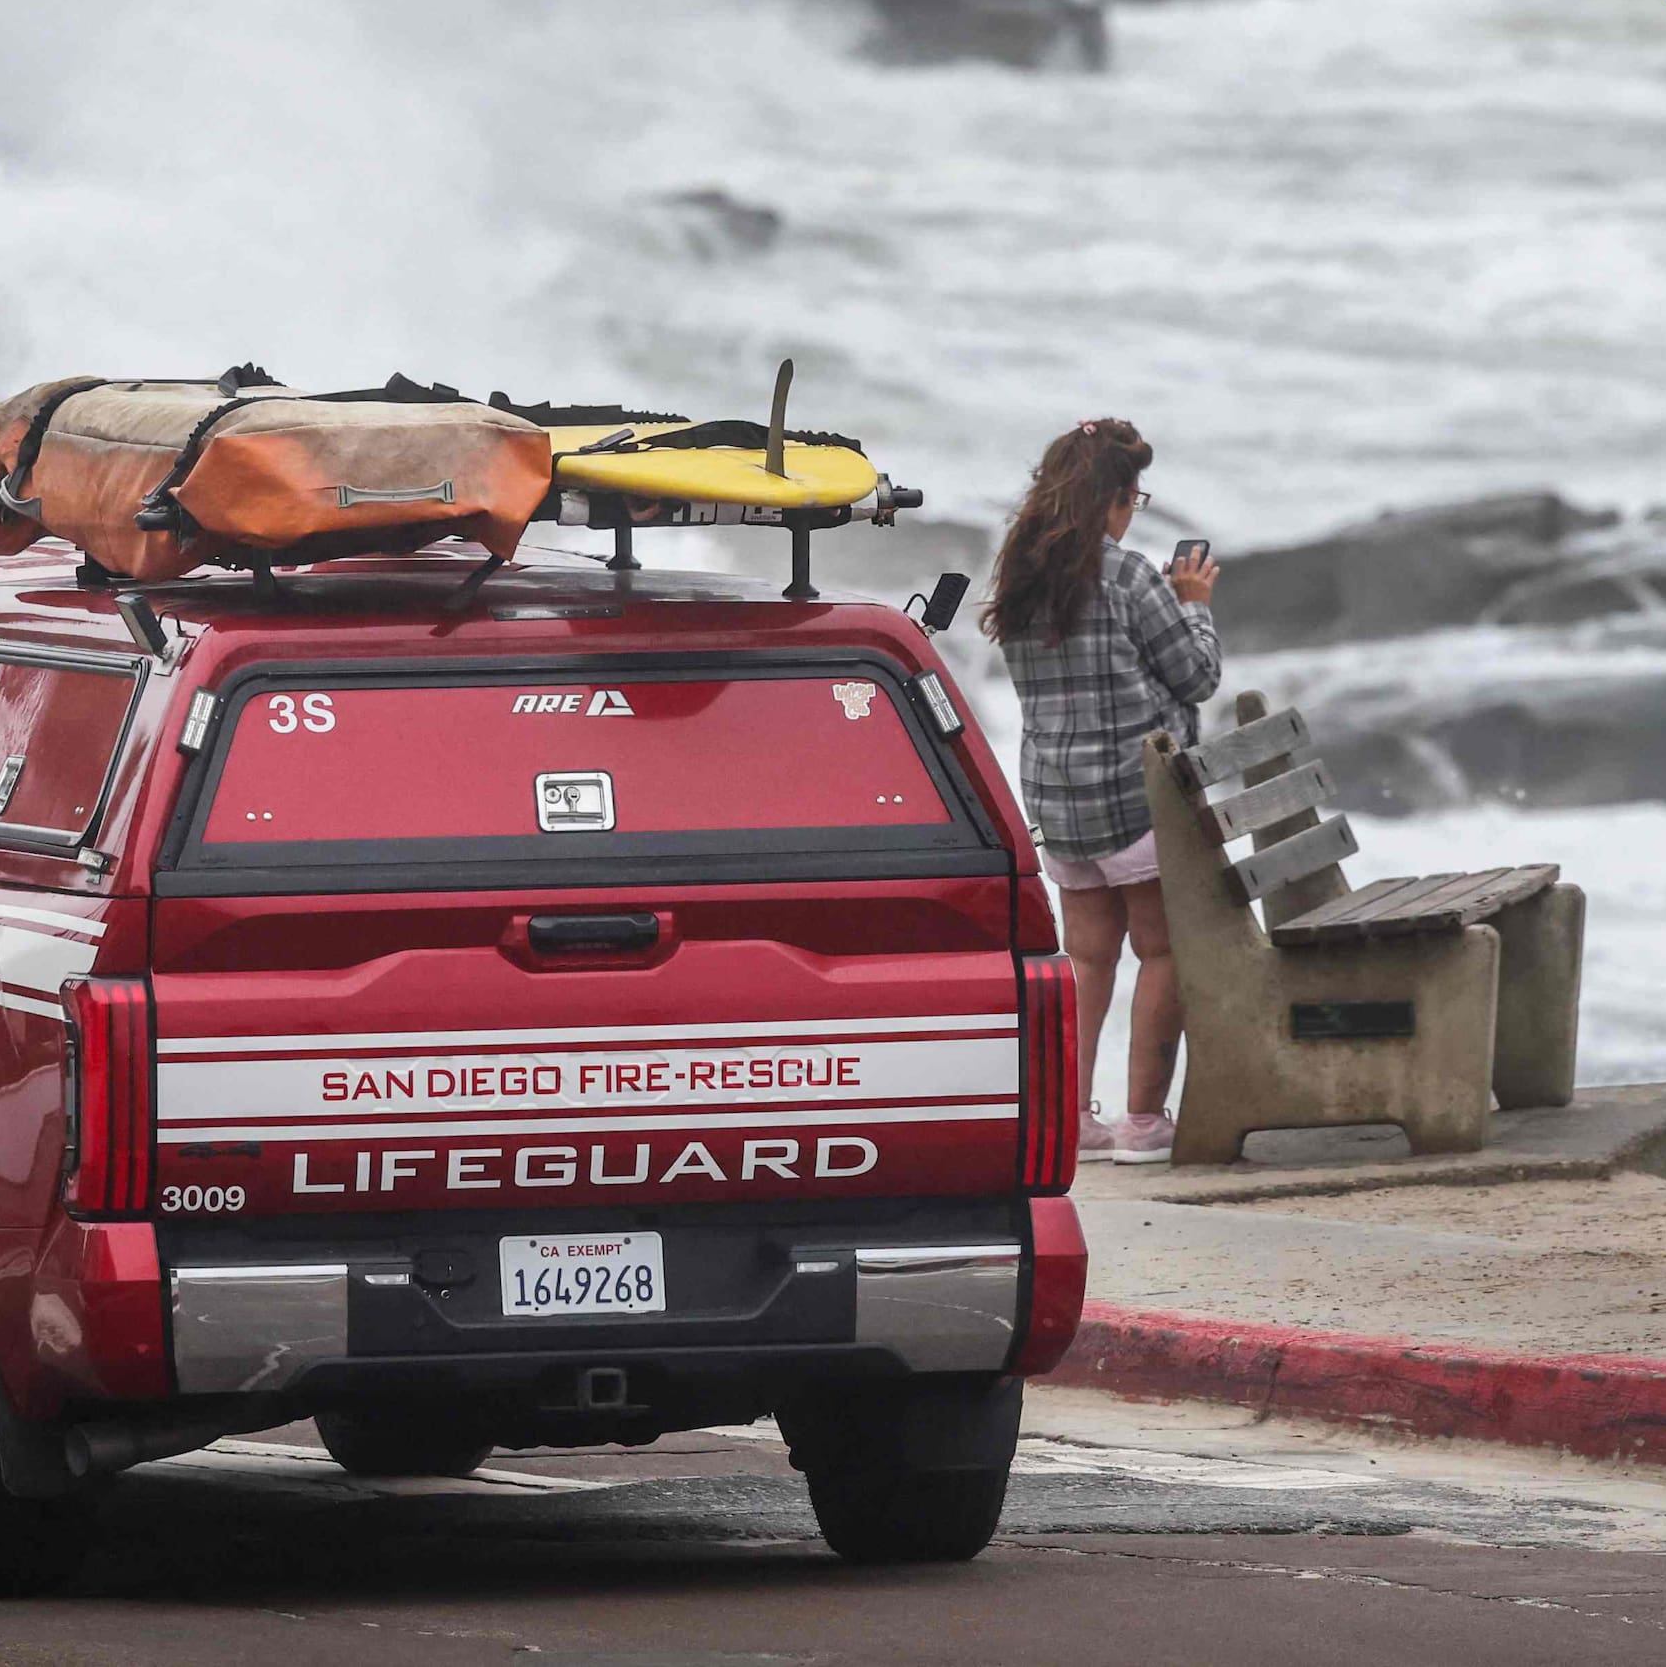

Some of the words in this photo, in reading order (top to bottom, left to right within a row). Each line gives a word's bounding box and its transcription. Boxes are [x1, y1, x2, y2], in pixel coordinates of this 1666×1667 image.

[269, 693, 336, 733] 3S
[512, 694, 583, 713] ARE
[322, 1070, 414, 1101] SAN
[428, 1066, 561, 1098] DIEGO
[580, 1057, 861, 1094] FIRE-RESCUE
[293, 1136, 879, 1193] LIFEGUARD
[161, 1185, 246, 1212] 3009
[540, 1246, 560, 1258] CA
[567, 1244, 623, 1257] EXEMPT
[515, 1265, 653, 1306] 1649268
